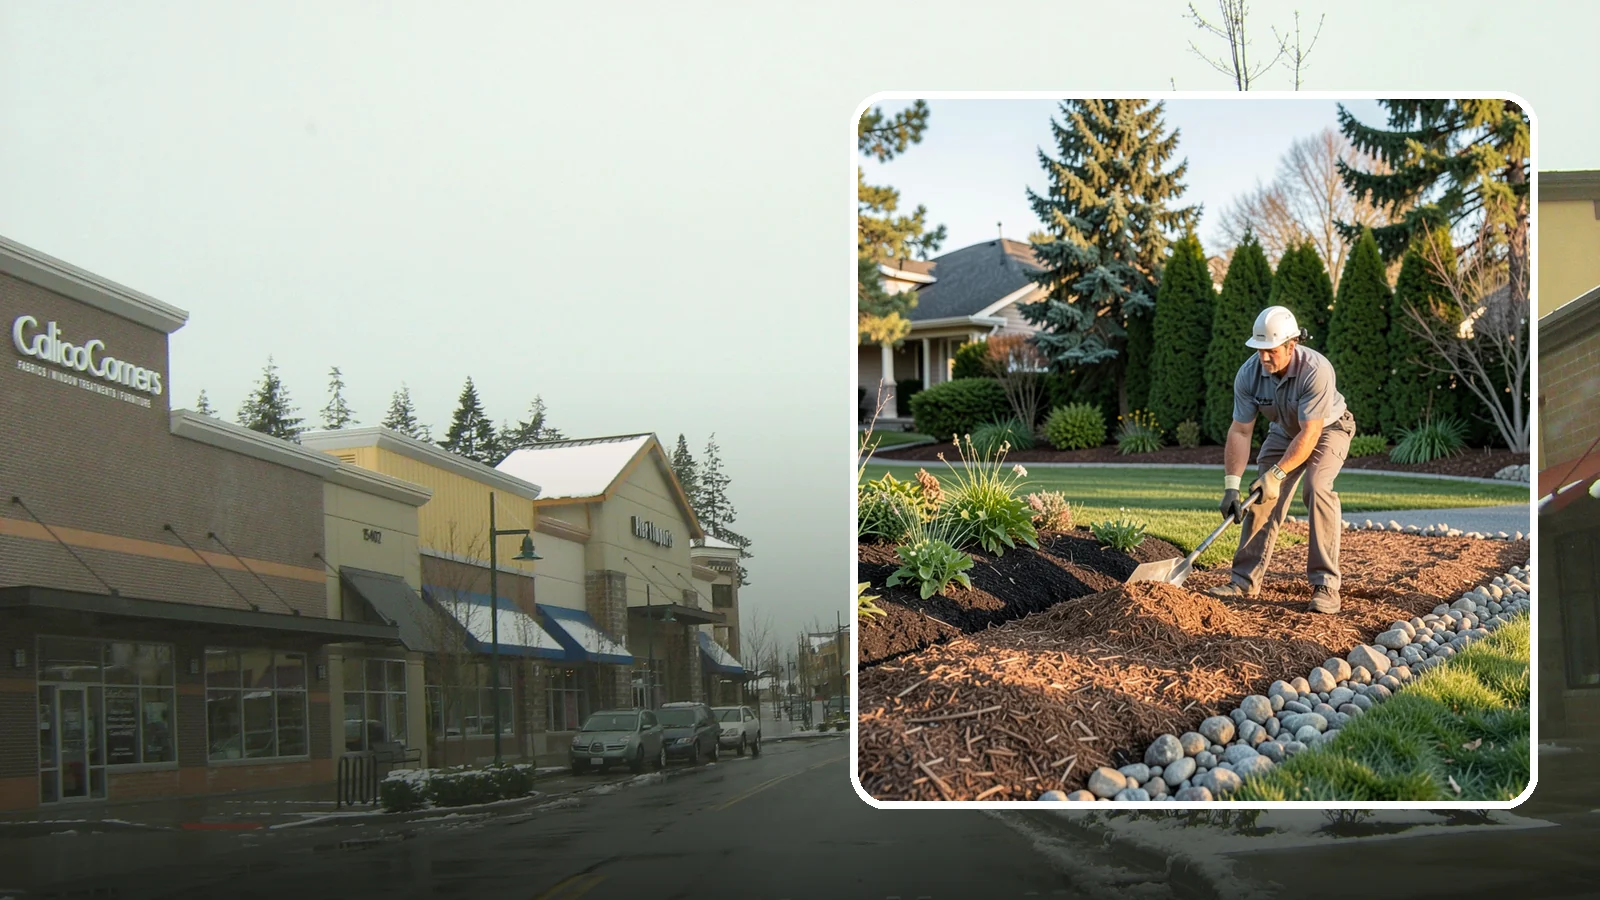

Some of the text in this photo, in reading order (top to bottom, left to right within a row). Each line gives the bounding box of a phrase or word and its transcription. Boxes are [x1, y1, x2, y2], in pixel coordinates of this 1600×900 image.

[12, 315, 162, 395] CalicoCorners
[16, 359, 151, 408] FABRICS WINDOW TREATMENTS FURNITURE
